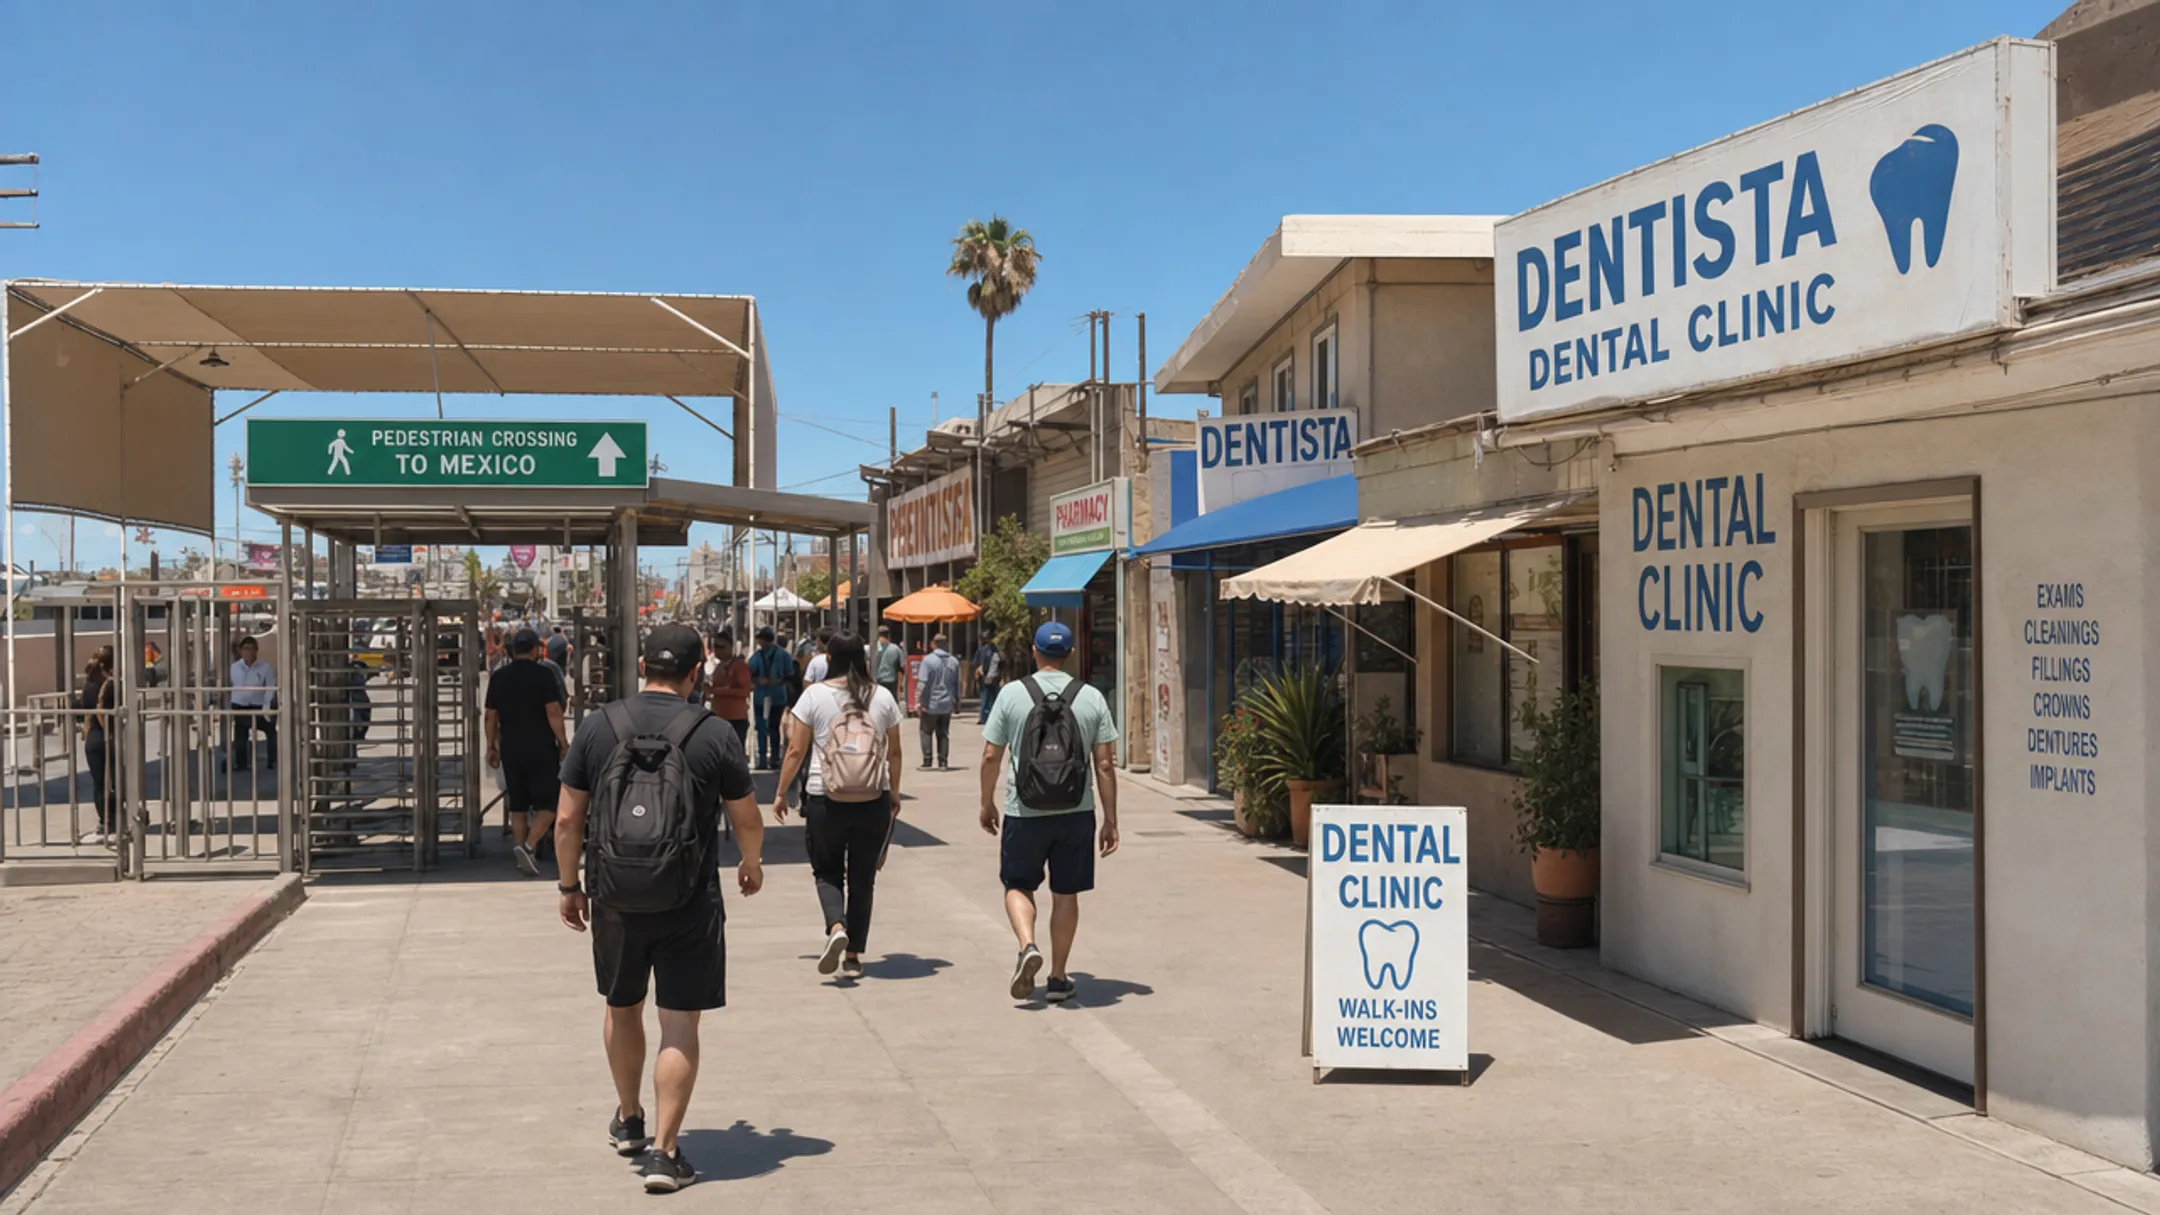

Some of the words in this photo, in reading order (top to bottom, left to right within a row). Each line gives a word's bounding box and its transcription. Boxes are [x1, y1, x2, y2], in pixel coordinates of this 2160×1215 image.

[1517, 150, 1837, 331] DENTISTA
[1529, 317, 1669, 391] DENTAL
[1687, 272, 1835, 353] CLINIC
[372, 430, 483, 446] PEDESTRIAN
[492, 431, 577, 447] CROSSING
[1202, 416, 1353, 469] DENTISTA
[395, 454, 427, 474] TO
[440, 454, 535, 475] MEXICO
[1633, 473, 1776, 552] DENTAL
[1638, 559, 1764, 633] CLINIC
[2037, 583, 2084, 608] EXAMS
[2024, 619, 2100, 646] CLEANINGS
[2032, 656, 2091, 683] FILLINGS
[2033, 692, 2091, 720] CROWNS
[2028, 728, 2098, 758] DENTURES
[2030, 764, 2096, 796] IMPLANTS
[1322, 823, 1460, 865] DENTAL
[1338, 874, 1444, 910] CLINIC
[1338, 997, 1438, 1021] WALK-INS
[1337, 1026, 1440, 1050] WELCOME
